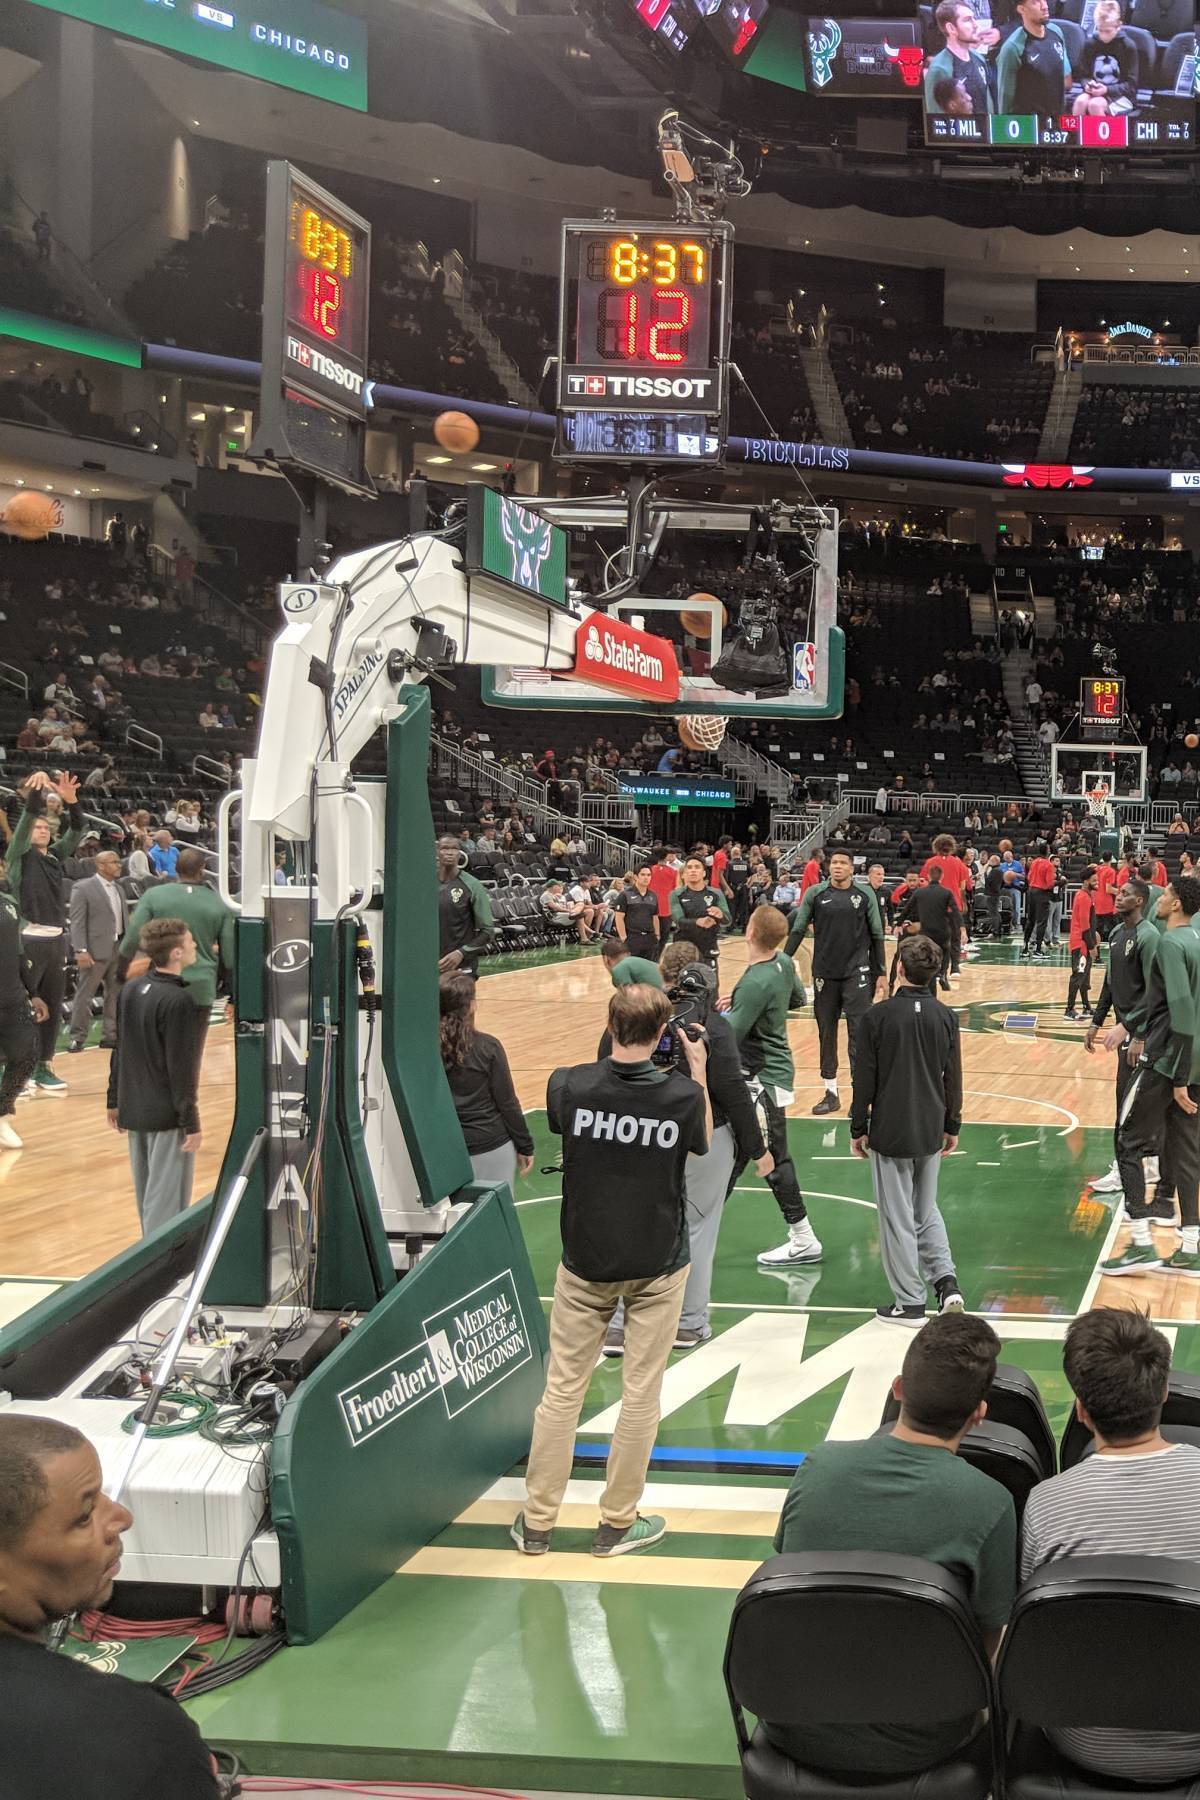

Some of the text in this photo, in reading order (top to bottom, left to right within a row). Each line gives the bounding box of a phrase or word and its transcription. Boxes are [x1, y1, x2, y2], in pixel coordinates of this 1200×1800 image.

[208, 11, 349, 69] VS CHICAGO
[959, 119, 1020, 138] MIL 0
[1043, 131, 1068, 143] 8:37
[1048, 118, 1077, 129] 1 12
[1099, 122, 1158, 140] 0 CHI
[614, 242, 704, 283] 8:37
[314, 271, 341, 337] 12
[627, 290, 689, 361] 12
[1109, 324, 1127, 338] JACK
[310, 349, 363, 394] TISSOT
[607, 376, 711, 398] TISSOT
[744, 437, 849, 470] BULLS
[1183, 475, 1200, 485] VS
[333, 652, 384, 719] SPALDING
[1094, 682, 1119, 694] 8:37
[1097, 695, 1115, 714] 12
[621, 786, 670, 796] MILWAUKEE
[695, 790, 731, 798] CHICAGO
[573, 1107, 680, 1149] PHOTO
[454, 1293, 512, 1343] MEDICAL
[453, 1314, 517, 1366] COLLEGE of
[457, 1330, 526, 1390] WISCONSIN
[346, 1358, 436, 1434] Froedtert
[436, 1347, 453, 1375] &
